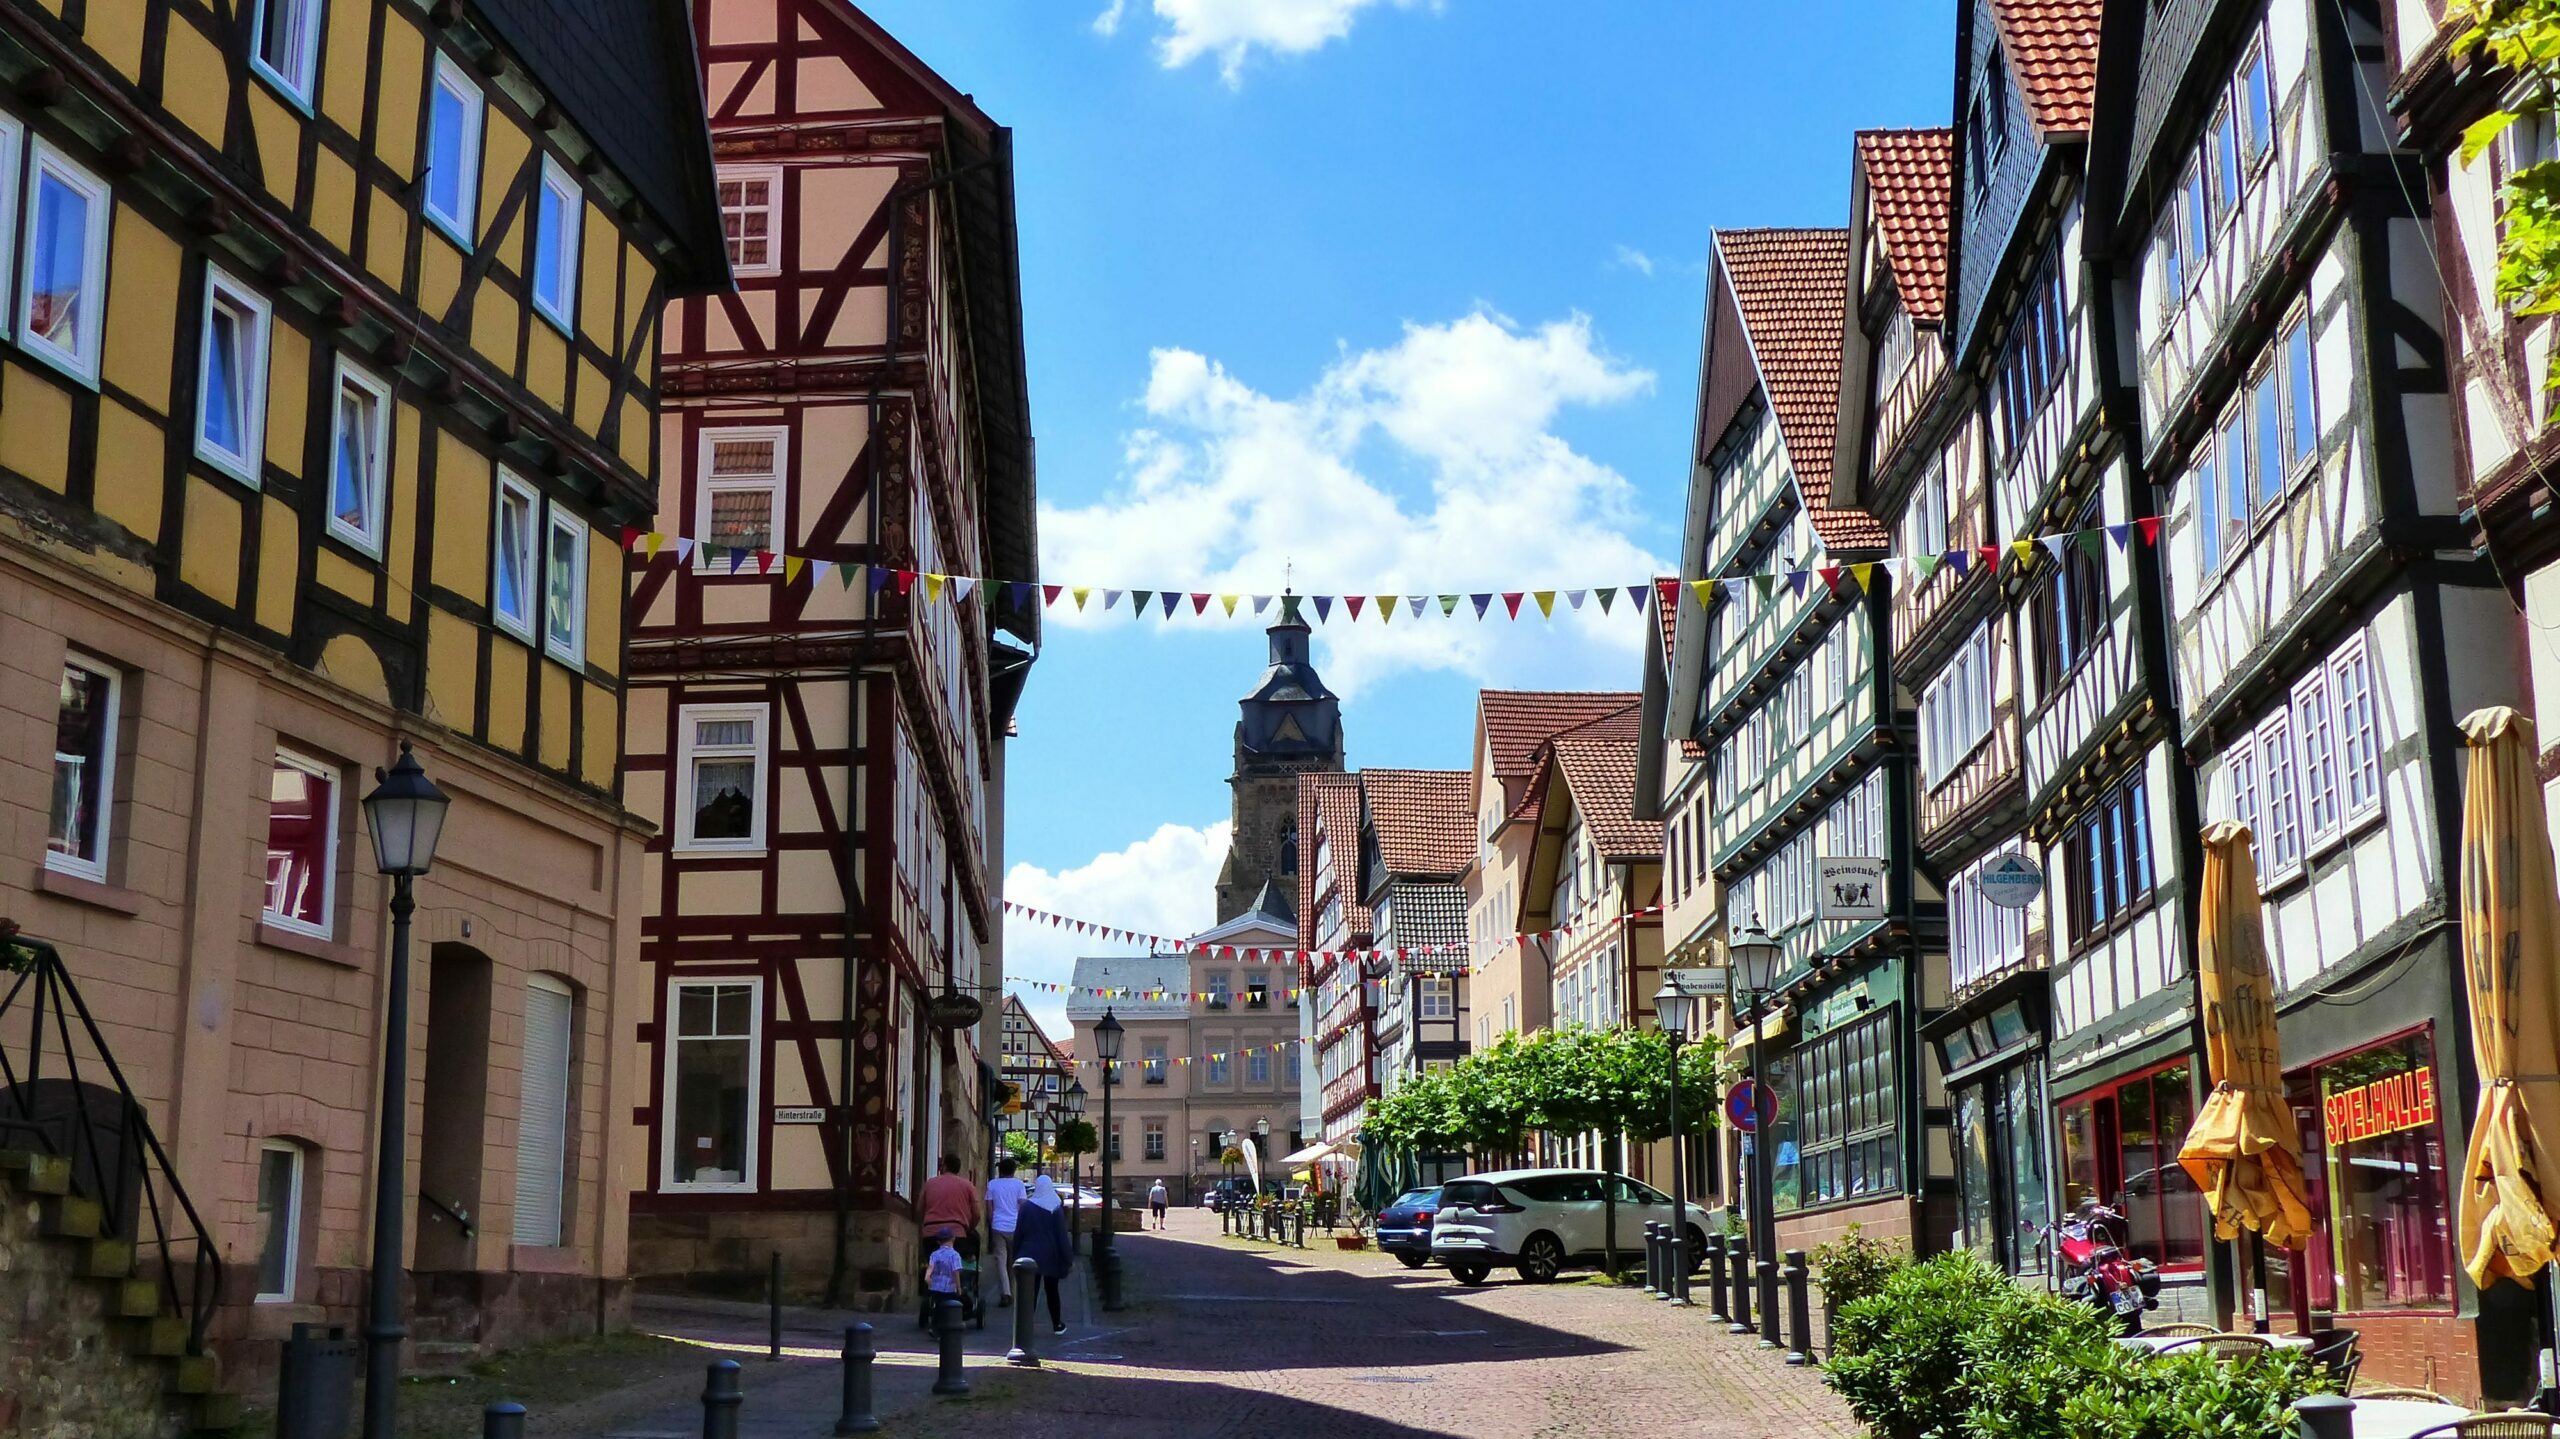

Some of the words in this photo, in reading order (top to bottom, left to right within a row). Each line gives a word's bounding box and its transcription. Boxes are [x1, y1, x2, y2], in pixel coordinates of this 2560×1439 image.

[1823, 865, 1879, 878] Weinstube
[1983, 873, 2041, 885] HILGENBERG
[2325, 1066, 2434, 1146] SPIELHALLE
[778, 1110, 822, 1120] Hinterstraße
